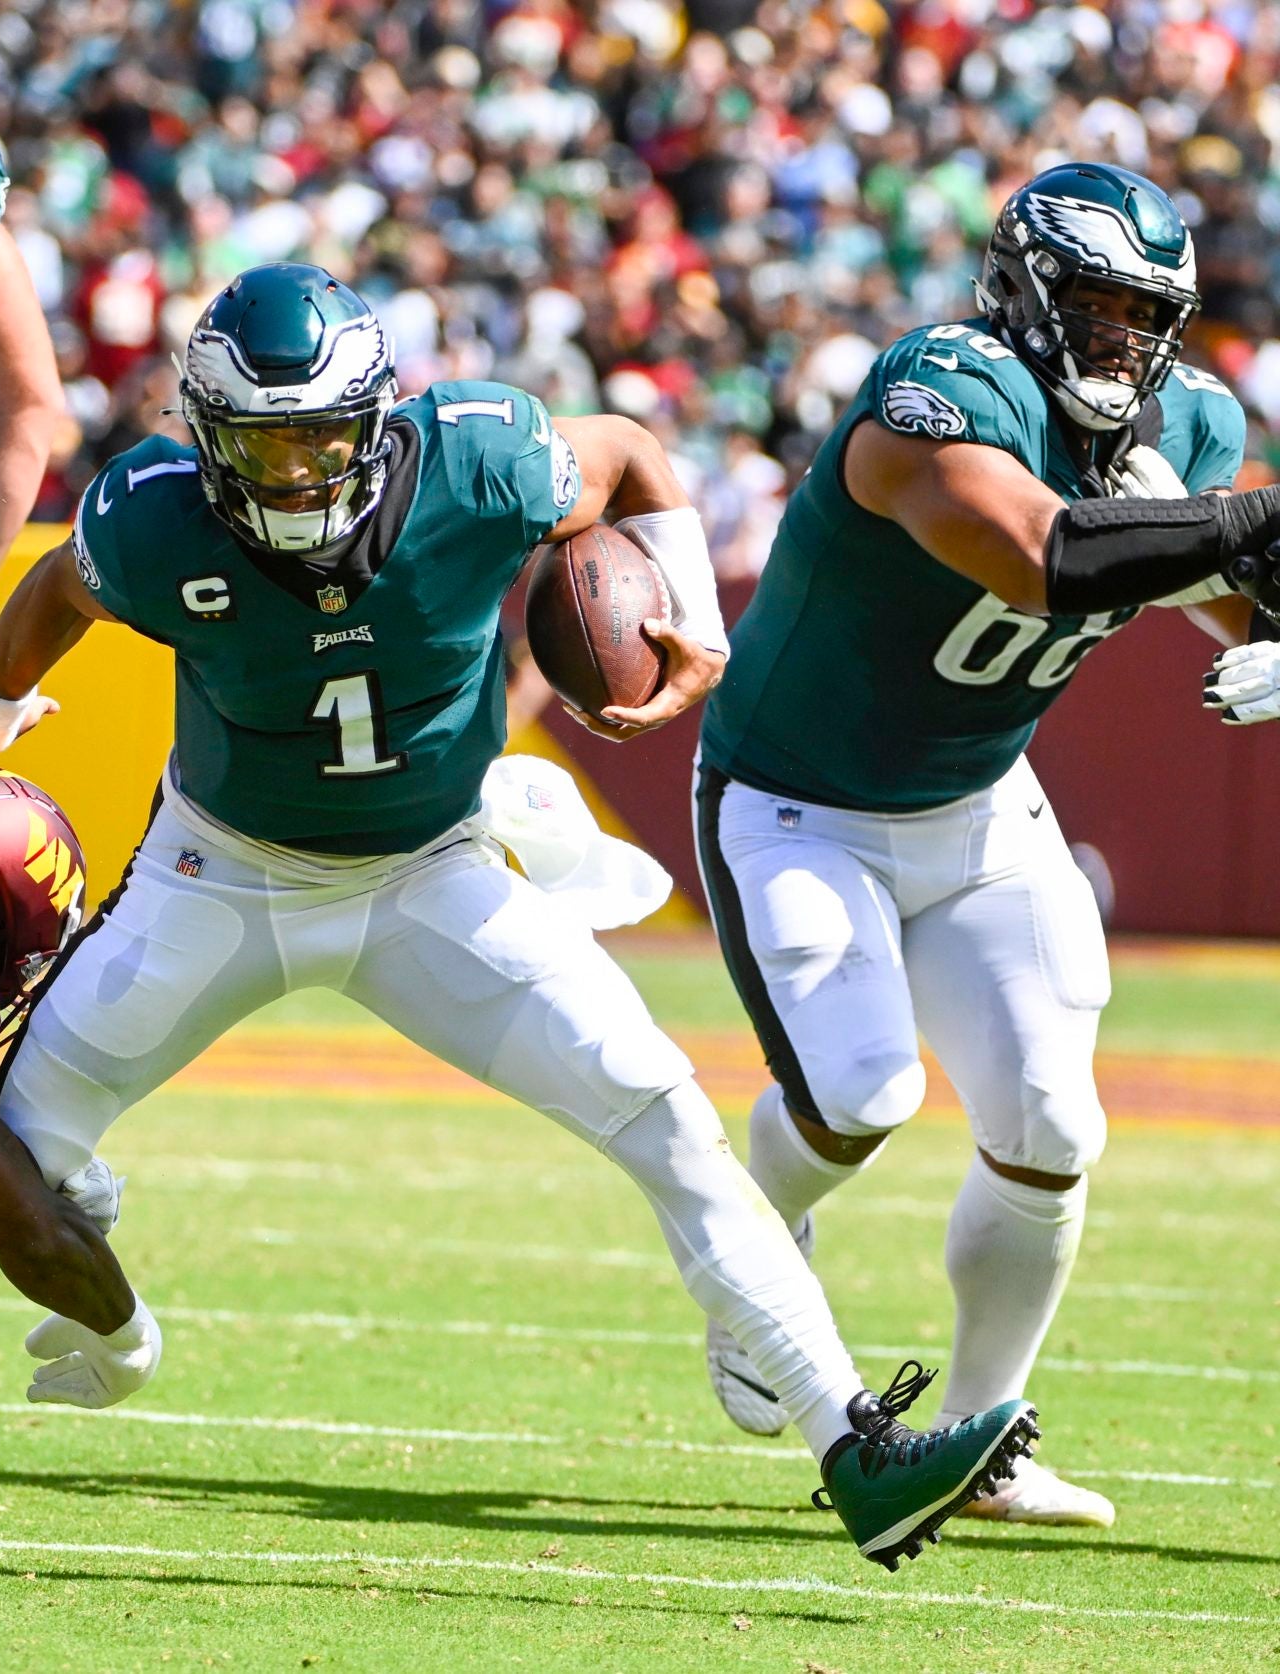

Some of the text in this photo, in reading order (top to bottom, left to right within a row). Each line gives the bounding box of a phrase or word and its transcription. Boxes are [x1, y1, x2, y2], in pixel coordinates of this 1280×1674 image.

[435, 399, 514, 427] 1
[128, 459, 197, 492] 1
[182, 576, 231, 612] C
[585, 560, 600, 599] Wilson
[322, 598, 344, 610] NFL
[312, 625, 375, 652] EAGLES
[612, 606, 621, 647] LEAGUE
[310, 672, 402, 776] 1
[178, 860, 199, 877] NFL
